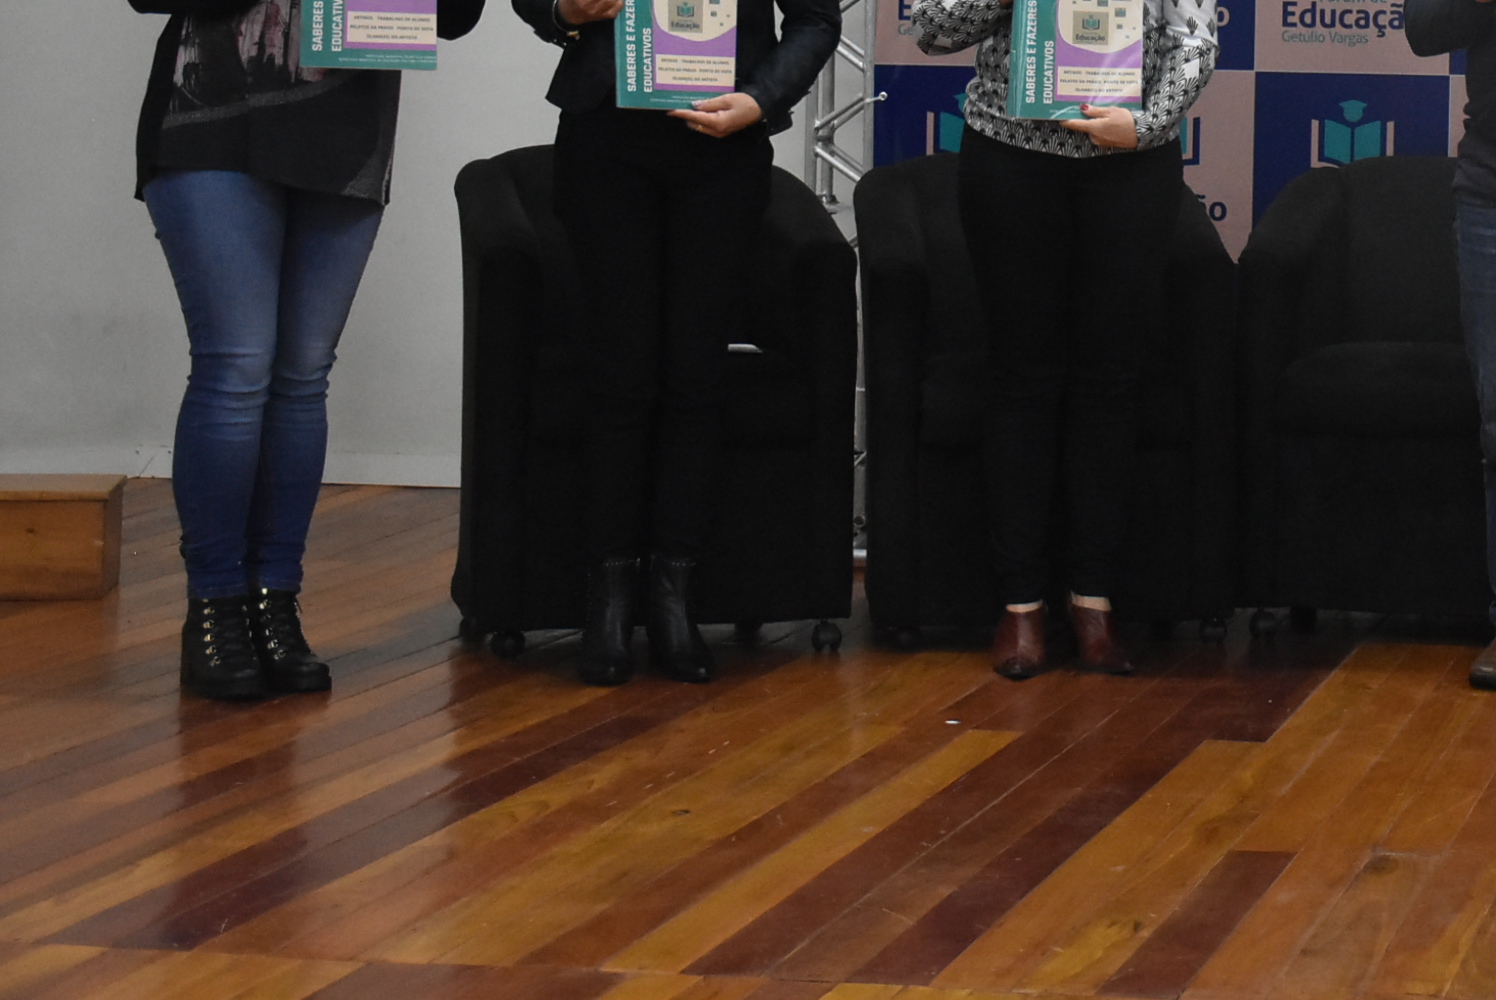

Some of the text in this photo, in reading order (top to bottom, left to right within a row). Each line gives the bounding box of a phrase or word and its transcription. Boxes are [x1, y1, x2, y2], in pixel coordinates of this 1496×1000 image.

[312, 0, 324, 51] SABERES
[1027, 0, 1038, 44] FAZERES
[1282, 2, 1404, 38] Educaçã
[1329, 32, 1369, 47] Vargas
[627, 44, 636, 92] SABERES
[643, 28, 652, 92] EDUCATIVOS
[1026, 56, 1036, 104] SABERES
[1044, 40, 1054, 104] EDUCATIVOS
